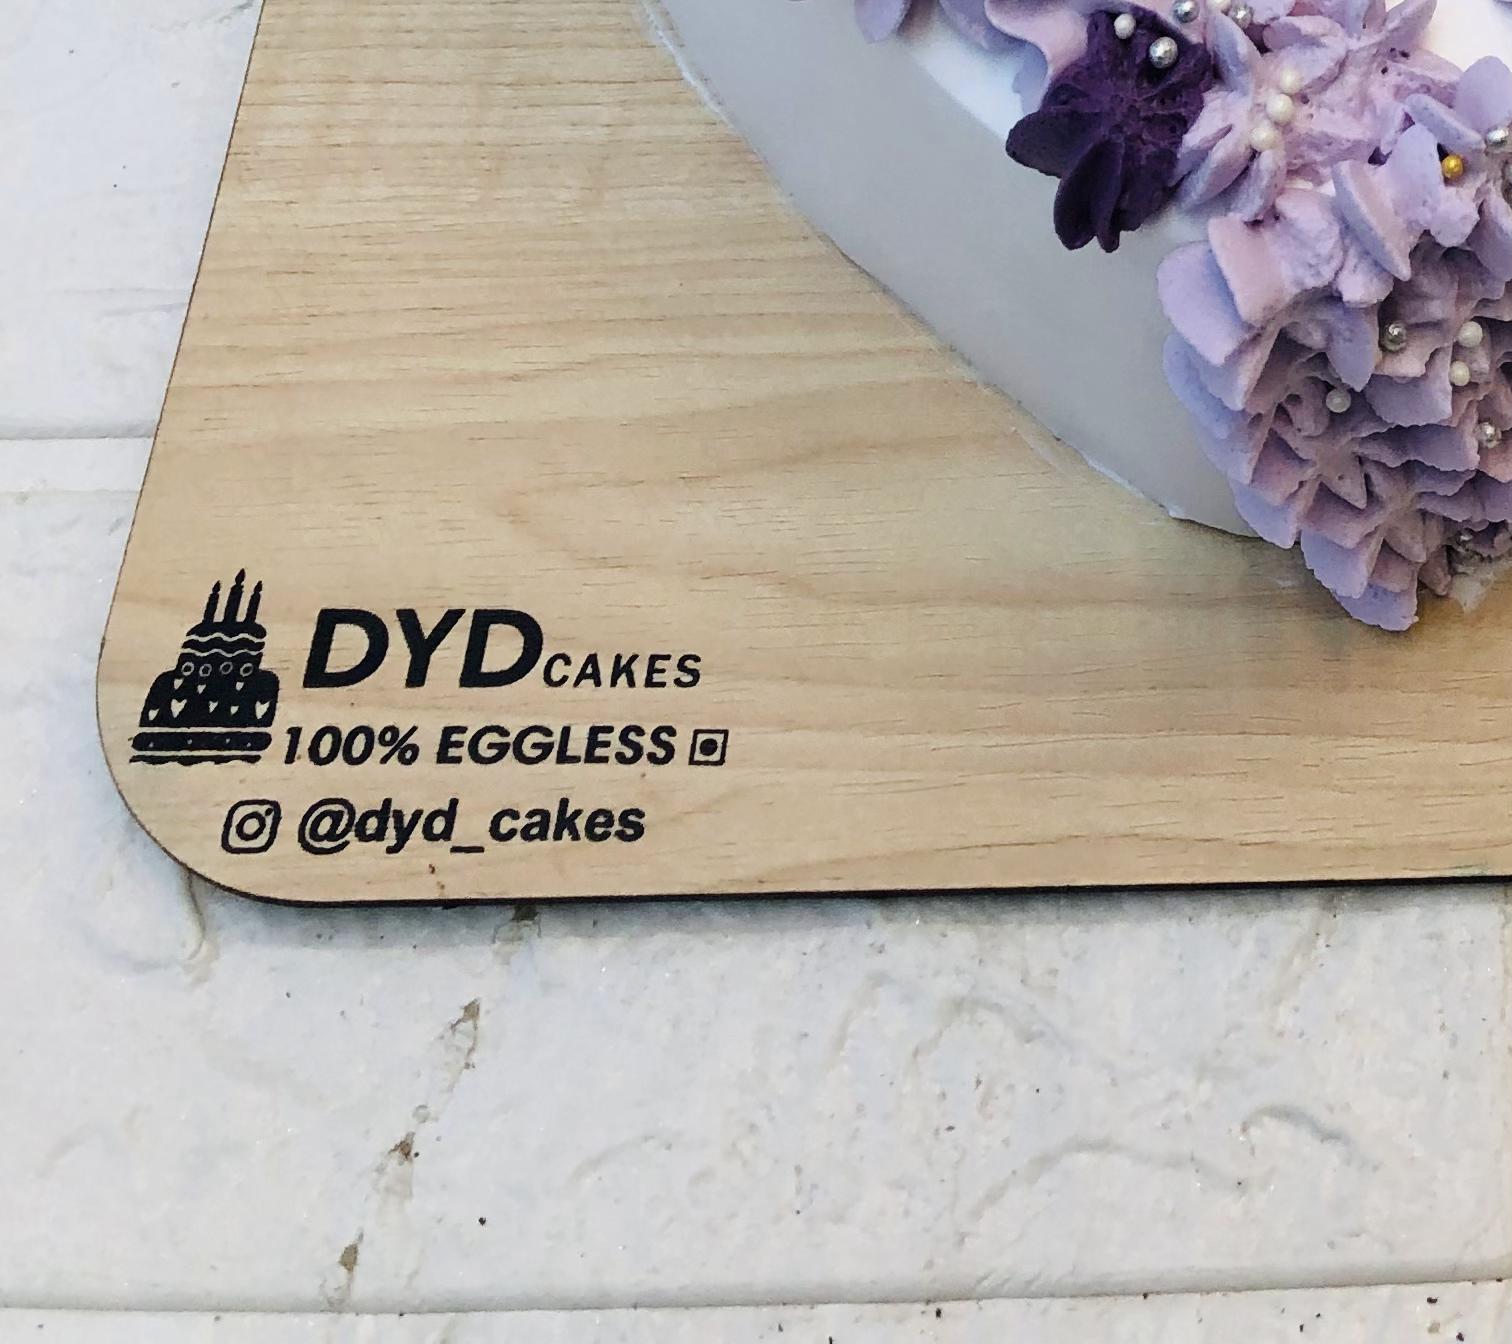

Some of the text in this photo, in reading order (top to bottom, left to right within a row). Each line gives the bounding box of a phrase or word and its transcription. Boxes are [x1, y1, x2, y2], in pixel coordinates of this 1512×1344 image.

[302, 608, 702, 689] DYD CAKES
[284, 724, 677, 767] 100% EGGLESS
[297, 797, 646, 855] @dyd_cakes
